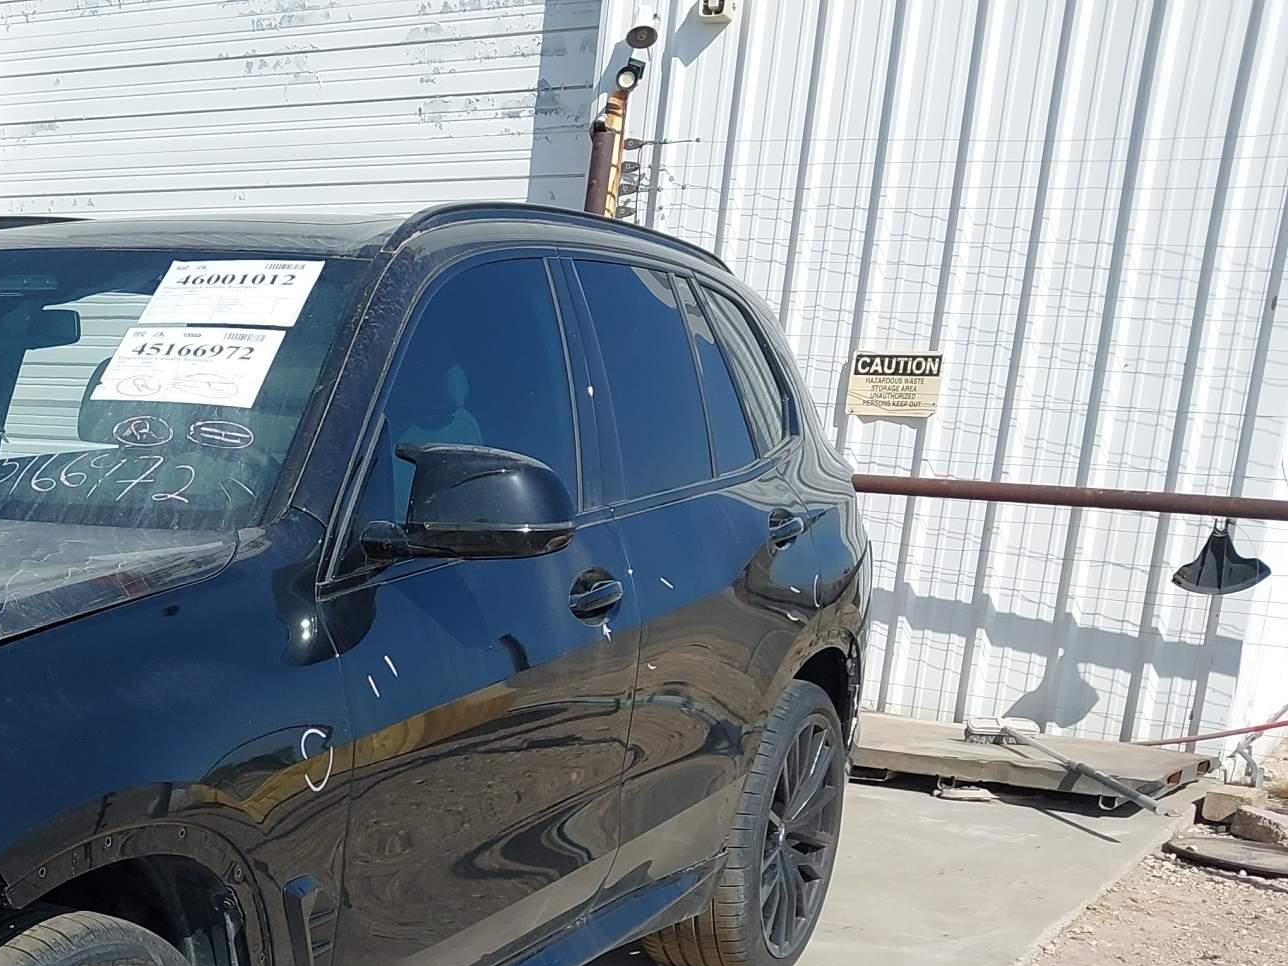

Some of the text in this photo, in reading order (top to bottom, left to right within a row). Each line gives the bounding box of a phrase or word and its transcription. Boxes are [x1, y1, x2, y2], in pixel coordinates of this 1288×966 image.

[176, 273, 297, 286] 46001012
[132, 342, 255, 361] 45166972
[857, 357, 939, 374] CAUTION
[865, 377, 925, 385] HAZARDOUS WASTE
[871, 384, 899, 392] STORAGE
[870, 392, 917, 400] UNAUTHORIZED
[862, 399, 891, 407] PERSONS
[908, 400, 922, 408] OUT
